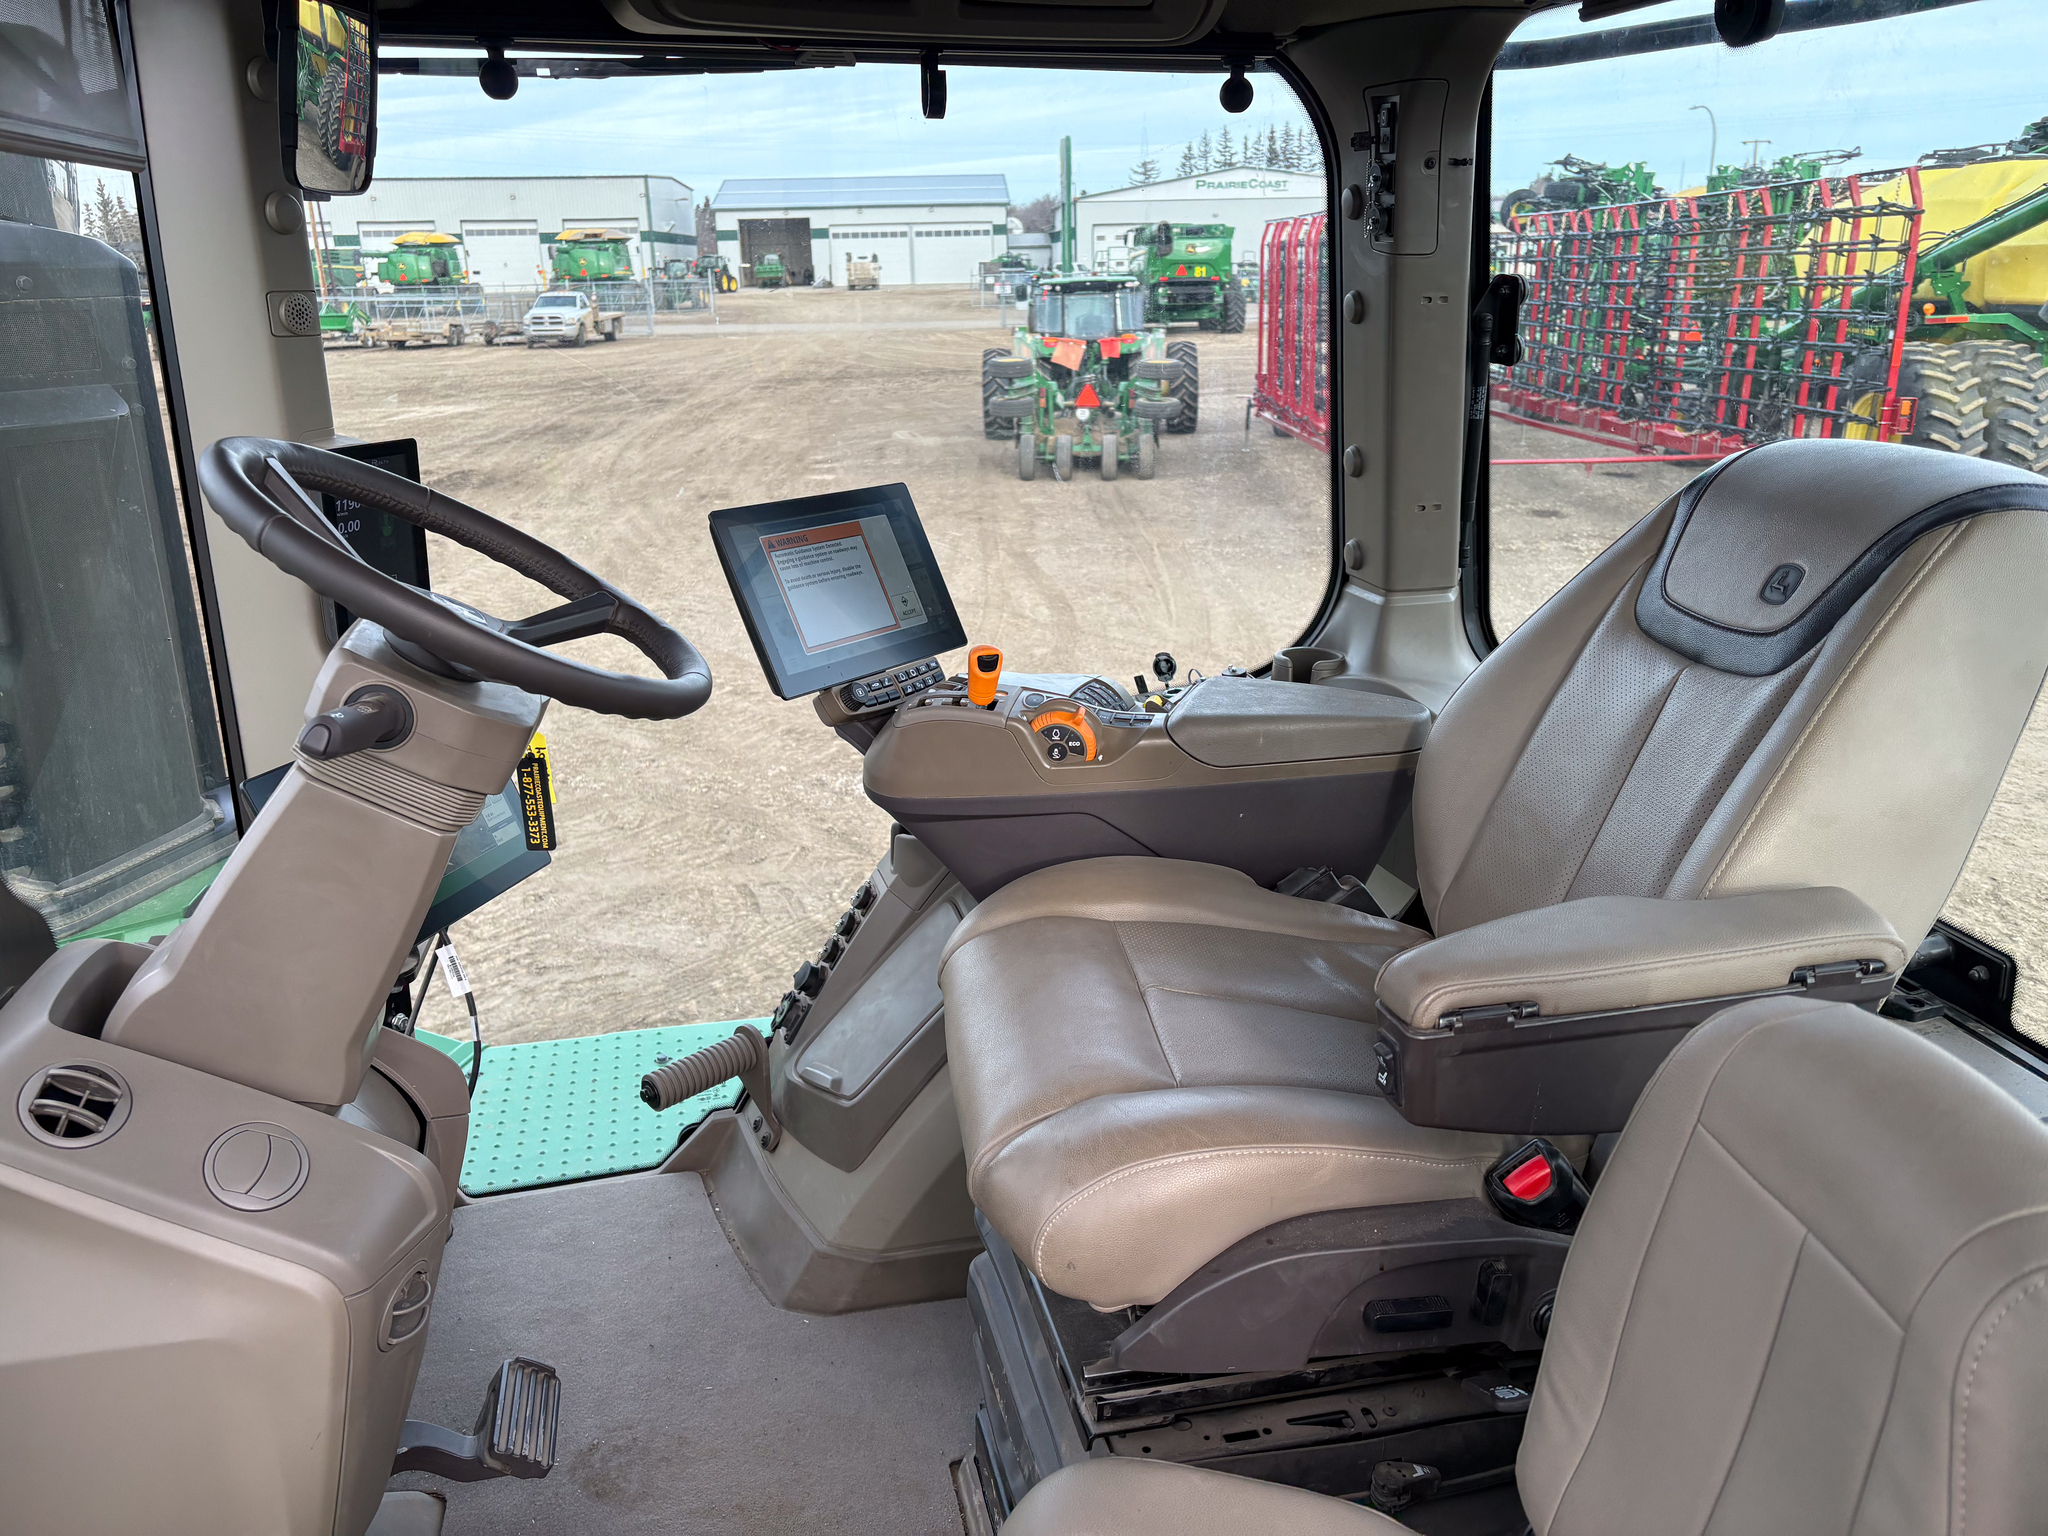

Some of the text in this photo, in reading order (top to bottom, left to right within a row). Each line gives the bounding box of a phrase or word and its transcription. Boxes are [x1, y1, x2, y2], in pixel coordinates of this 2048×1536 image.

[1194, 266, 1206, 278] 81
[338, 519, 360, 534] 0.00
[775, 534, 809, 547] WARNING
[798, 555, 814, 563] guidance
[788, 583, 805, 592] guidance
[521, 768, 540, 844] 1-877-553-3373
[532, 762, 548, 848] PRAIRIECOASTEQUIPMENT.COM
